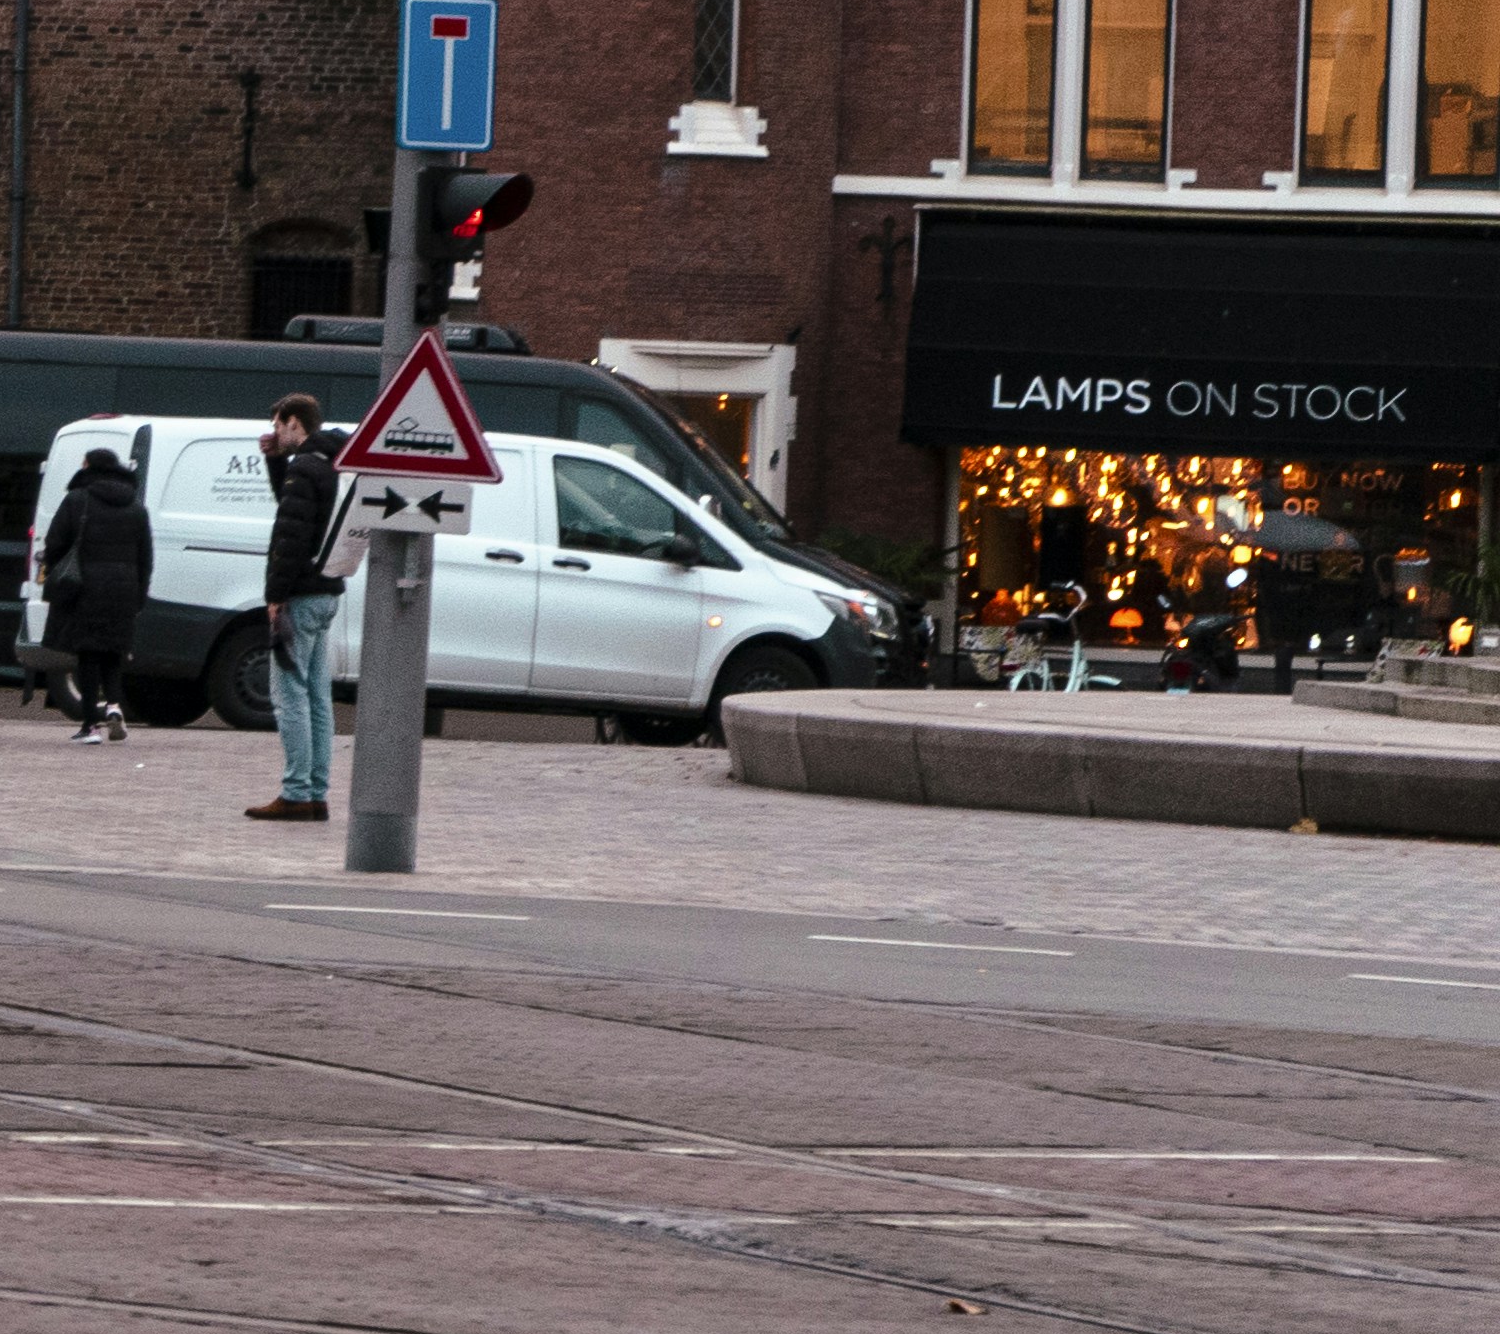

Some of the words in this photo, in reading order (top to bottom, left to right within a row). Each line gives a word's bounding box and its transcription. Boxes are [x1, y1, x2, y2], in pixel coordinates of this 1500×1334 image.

[991, 373, 1152, 415] LAMPS
[1166, 380, 1238, 417] ON
[1252, 382, 1409, 423] STOCK
